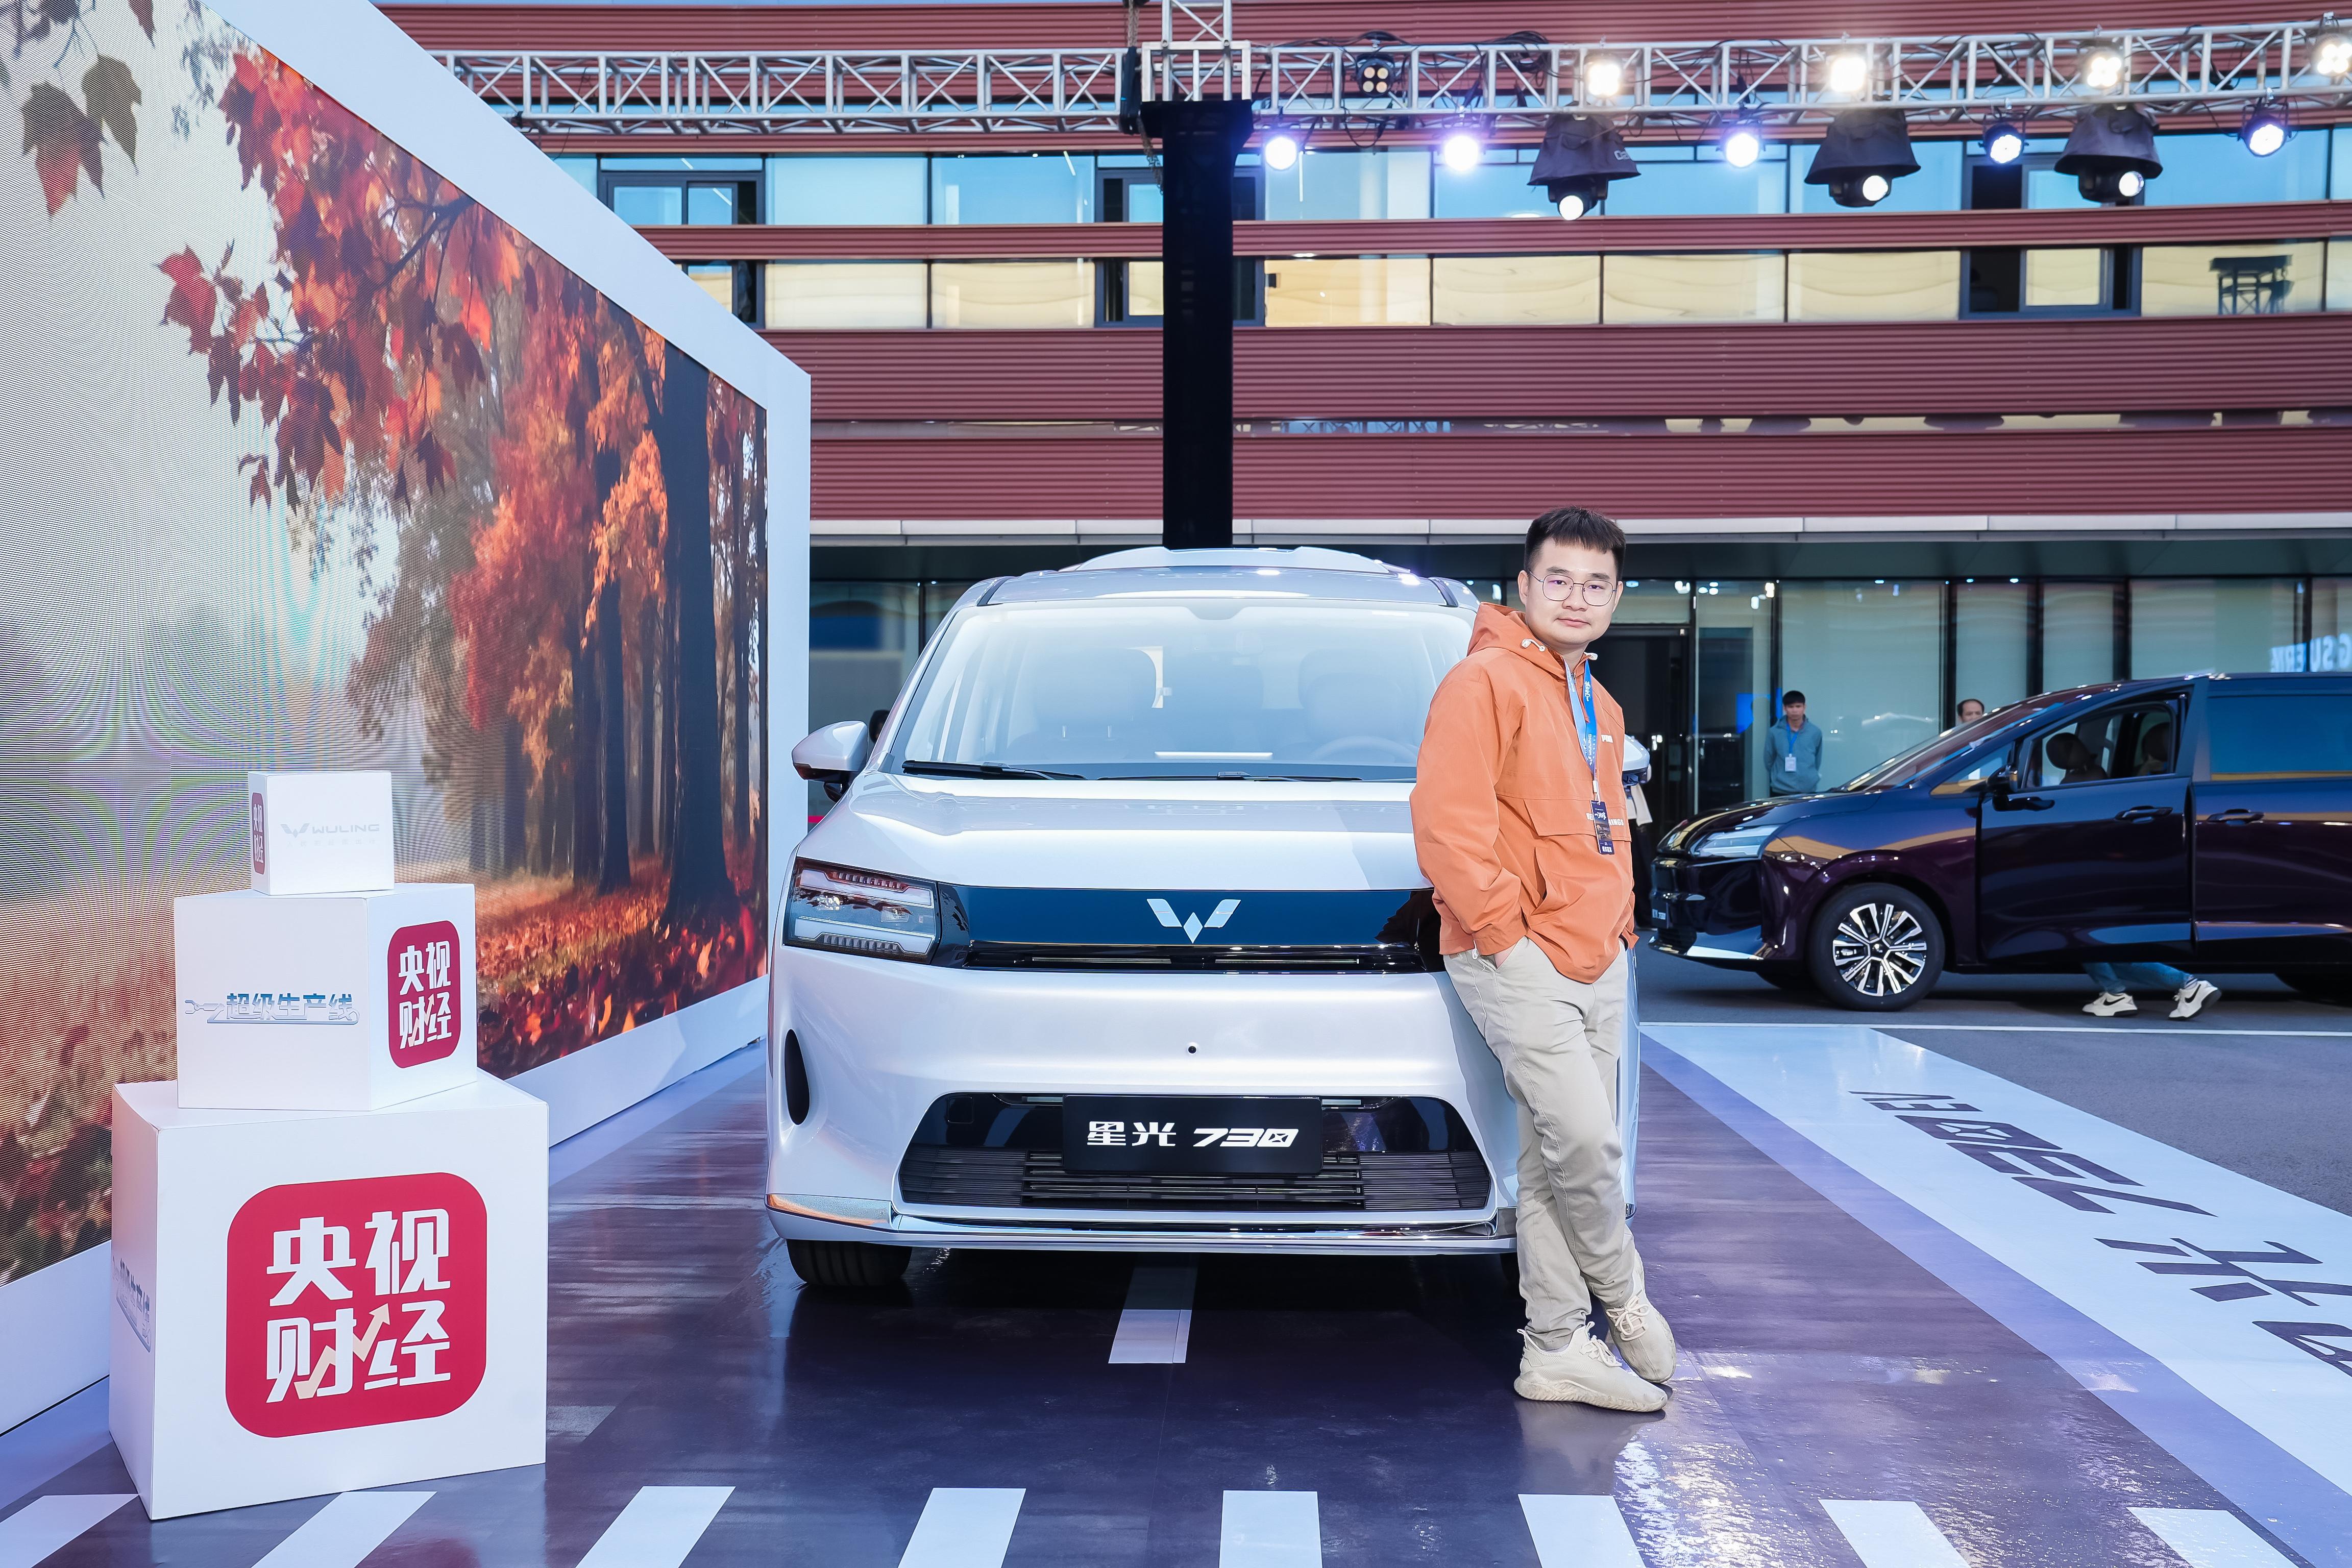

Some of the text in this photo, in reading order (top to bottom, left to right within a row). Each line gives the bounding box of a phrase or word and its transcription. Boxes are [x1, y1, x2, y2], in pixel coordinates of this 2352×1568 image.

[253, 803, 263, 832] 央视
[312, 824, 380, 834] WULING
[254, 834, 264, 863] 财经
[399, 941, 451, 996] 央视
[226, 992, 353, 1021] 超级生产线
[399, 995, 452, 1049] 财经
[1087, 1121, 1299, 1147] 星光 730
[266, 1208, 451, 1307] 央视
[265, 1300, 452, 1404] 财经
